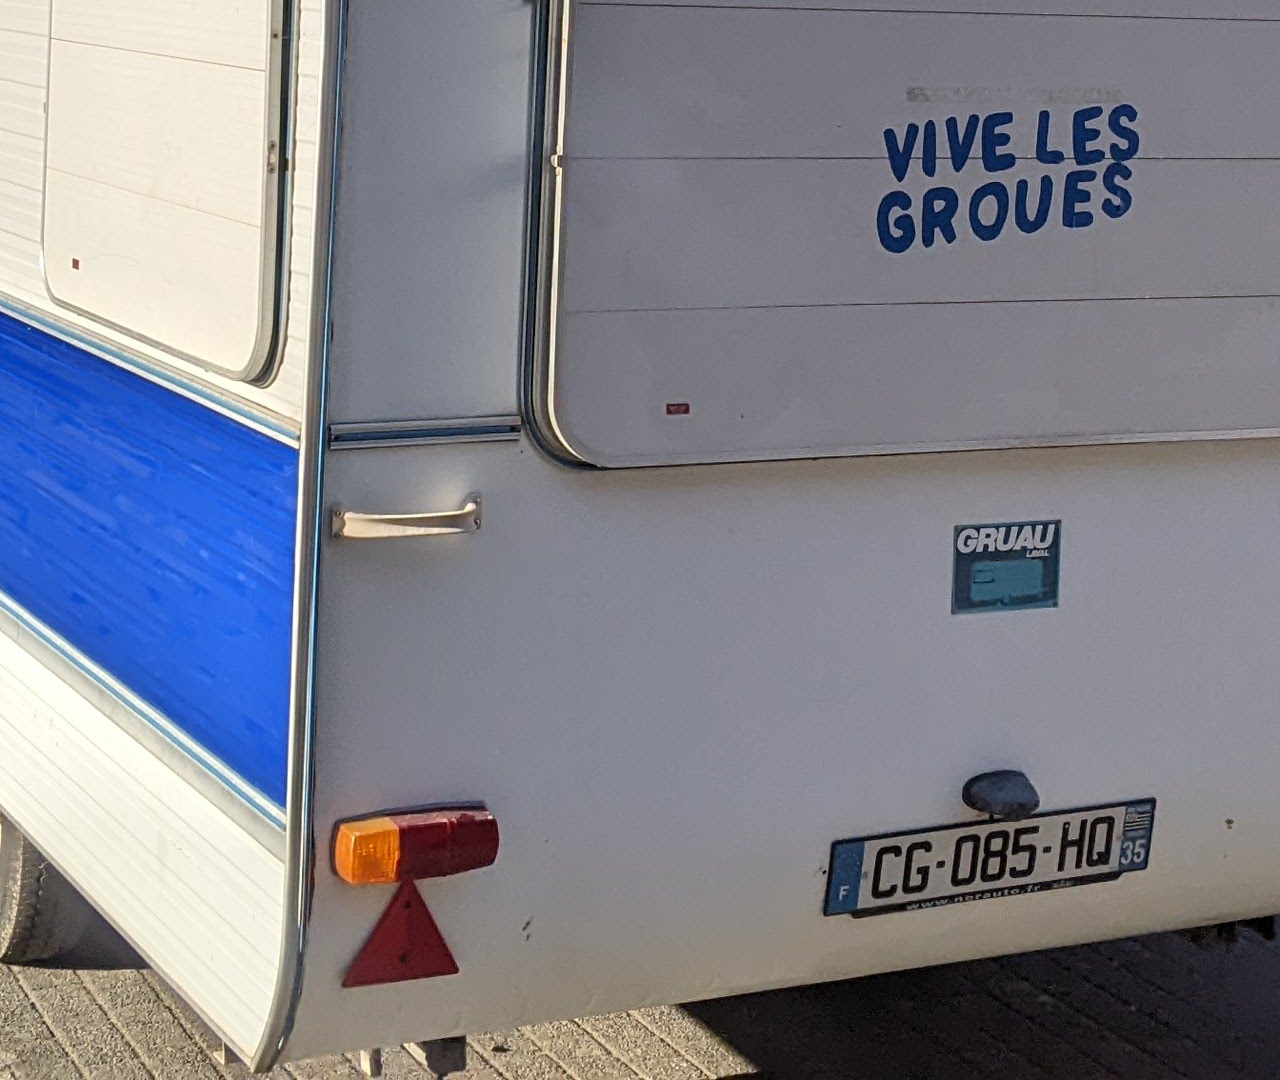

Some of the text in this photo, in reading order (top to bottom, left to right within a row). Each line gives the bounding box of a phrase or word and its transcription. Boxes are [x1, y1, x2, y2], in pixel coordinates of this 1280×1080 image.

[883, 103, 1140, 183] VIVE LES
[876, 161, 1133, 254] GROUES
[956, 524, 1056, 554] GRUAU
[1025, 549, 1050, 558] LAVAL
[838, 815, 1147, 901] F CG-085-HQ 35
